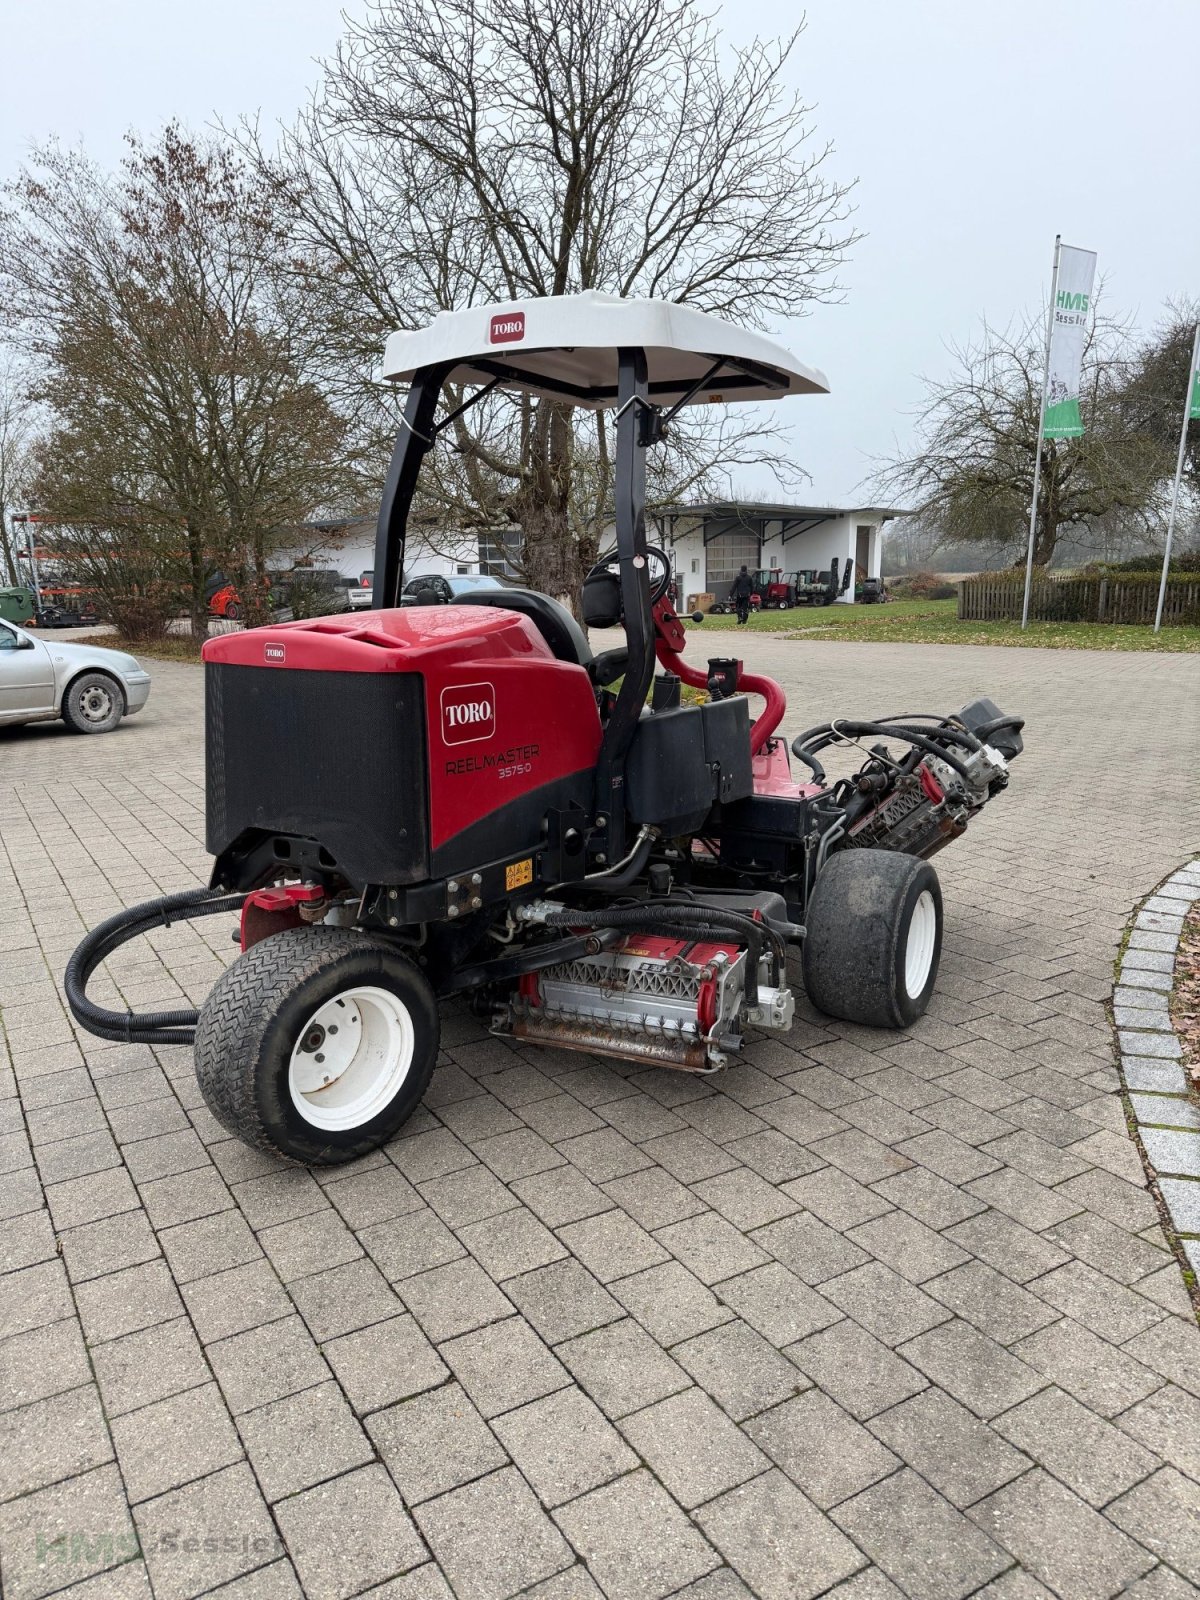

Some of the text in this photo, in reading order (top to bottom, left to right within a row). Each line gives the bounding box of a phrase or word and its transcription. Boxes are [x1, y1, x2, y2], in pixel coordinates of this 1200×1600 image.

[1056, 290, 1089, 312] HMS
[266, 649, 284, 657] TORO
[446, 745, 540, 776] REELMASTER
